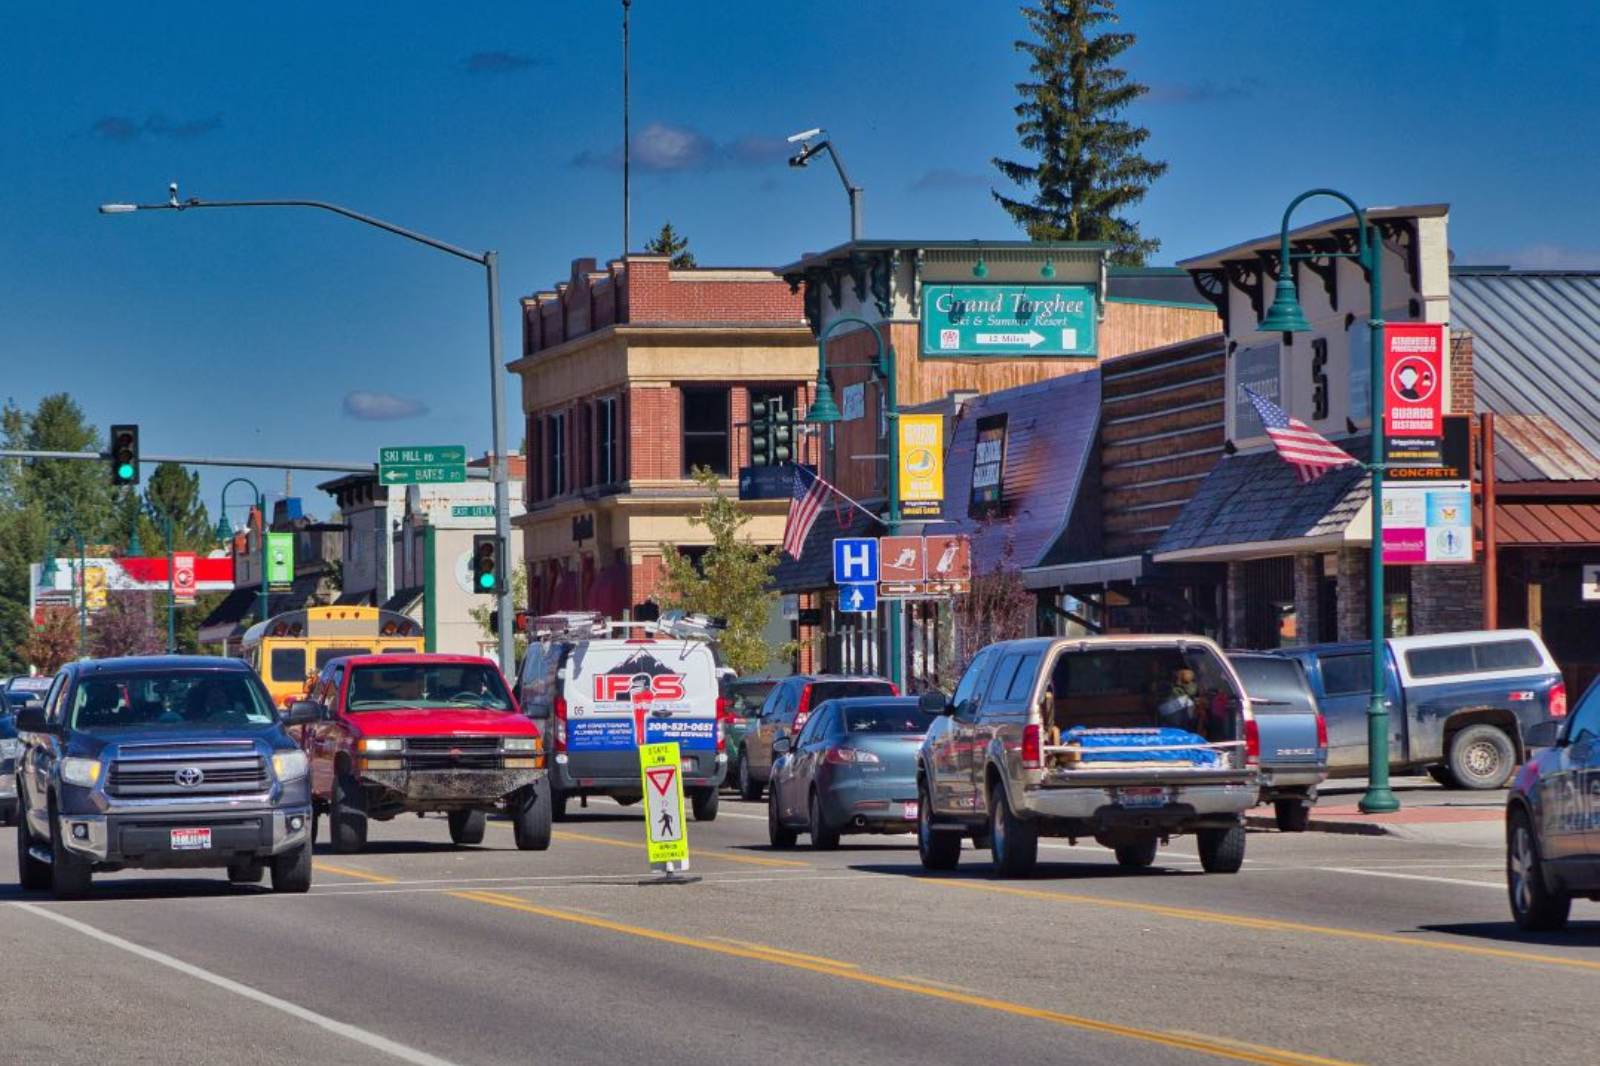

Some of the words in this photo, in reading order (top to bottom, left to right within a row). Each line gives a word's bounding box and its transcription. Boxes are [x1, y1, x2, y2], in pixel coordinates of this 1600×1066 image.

[936, 293, 1003, 314] Grand
[1012, 293, 1084, 319] Targhee
[952, 315, 969, 326] Ski
[973, 316, 983, 326] &
[987, 315, 1029, 326] Summer
[1034, 315, 1068, 326] Resort
[988, 335, 999, 343] 12
[1002, 335, 1025, 343] Miles
[384, 451, 399, 462] SKI
[402, 451, 421, 461] HILL
[424, 453, 434, 462] RD
[415, 469, 445, 480] BATES
[1390, 468, 1458, 477] CONCRETE
[843, 544, 870, 577] H
[648, 746, 668, 755] STATE
